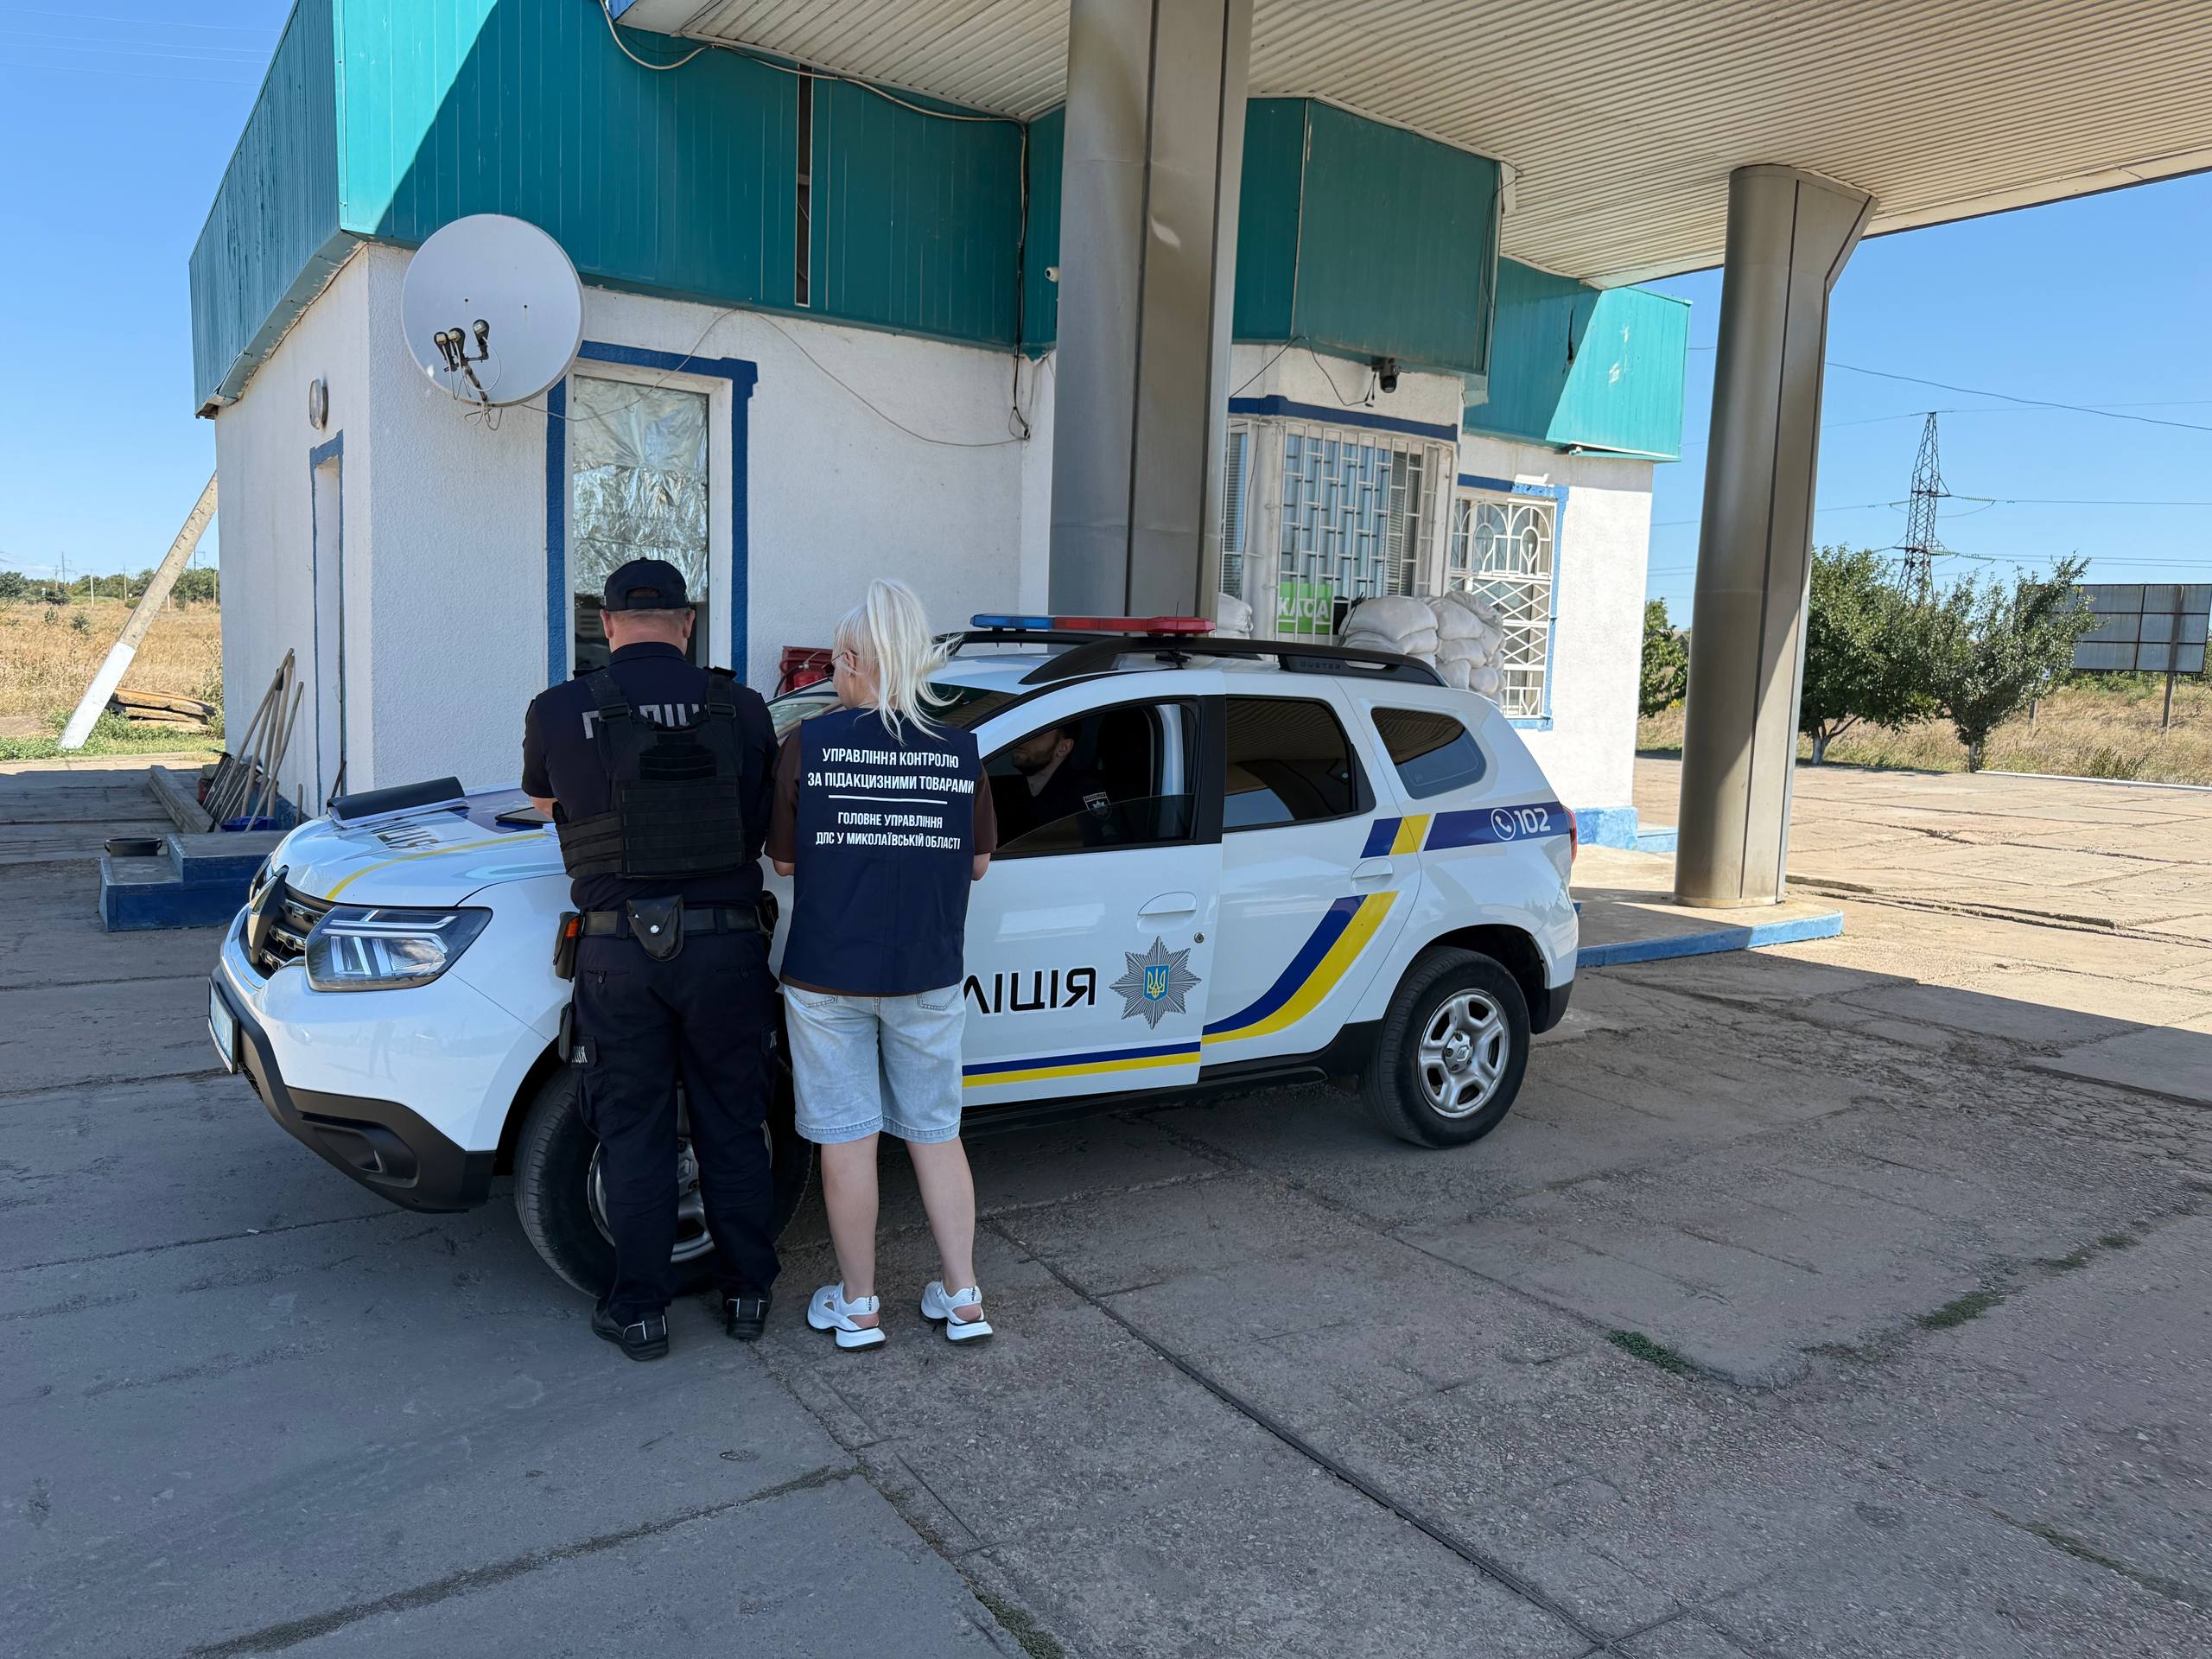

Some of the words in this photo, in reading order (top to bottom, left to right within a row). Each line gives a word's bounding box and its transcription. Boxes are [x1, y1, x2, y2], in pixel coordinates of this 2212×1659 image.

[1277, 596, 1330, 619] КАСА
[823, 748, 896, 766] УПРАВЛІННЯ
[899, 752, 958, 768] КОНТРОЛЮ
[808, 772, 822, 787] ЗА
[825, 772, 917, 789] ПІДАКЦИЗНИМИ
[919, 776, 974, 794] ТОВАРАМИ
[837, 812, 881, 826] ГОЛОВНЕ
[884, 815, 943, 829] УПРАВЛІННЯ
[1514, 807, 1551, 835] 102
[816, 832, 835, 845] ДПС
[836, 833, 844, 844] У
[846, 832, 924, 848] МИКОЛАЇВСЬКІЙ
[925, 836, 961, 850] ОБЛАСТІ
[963, 967, 1096, 1014] ЛІЦІЯ
